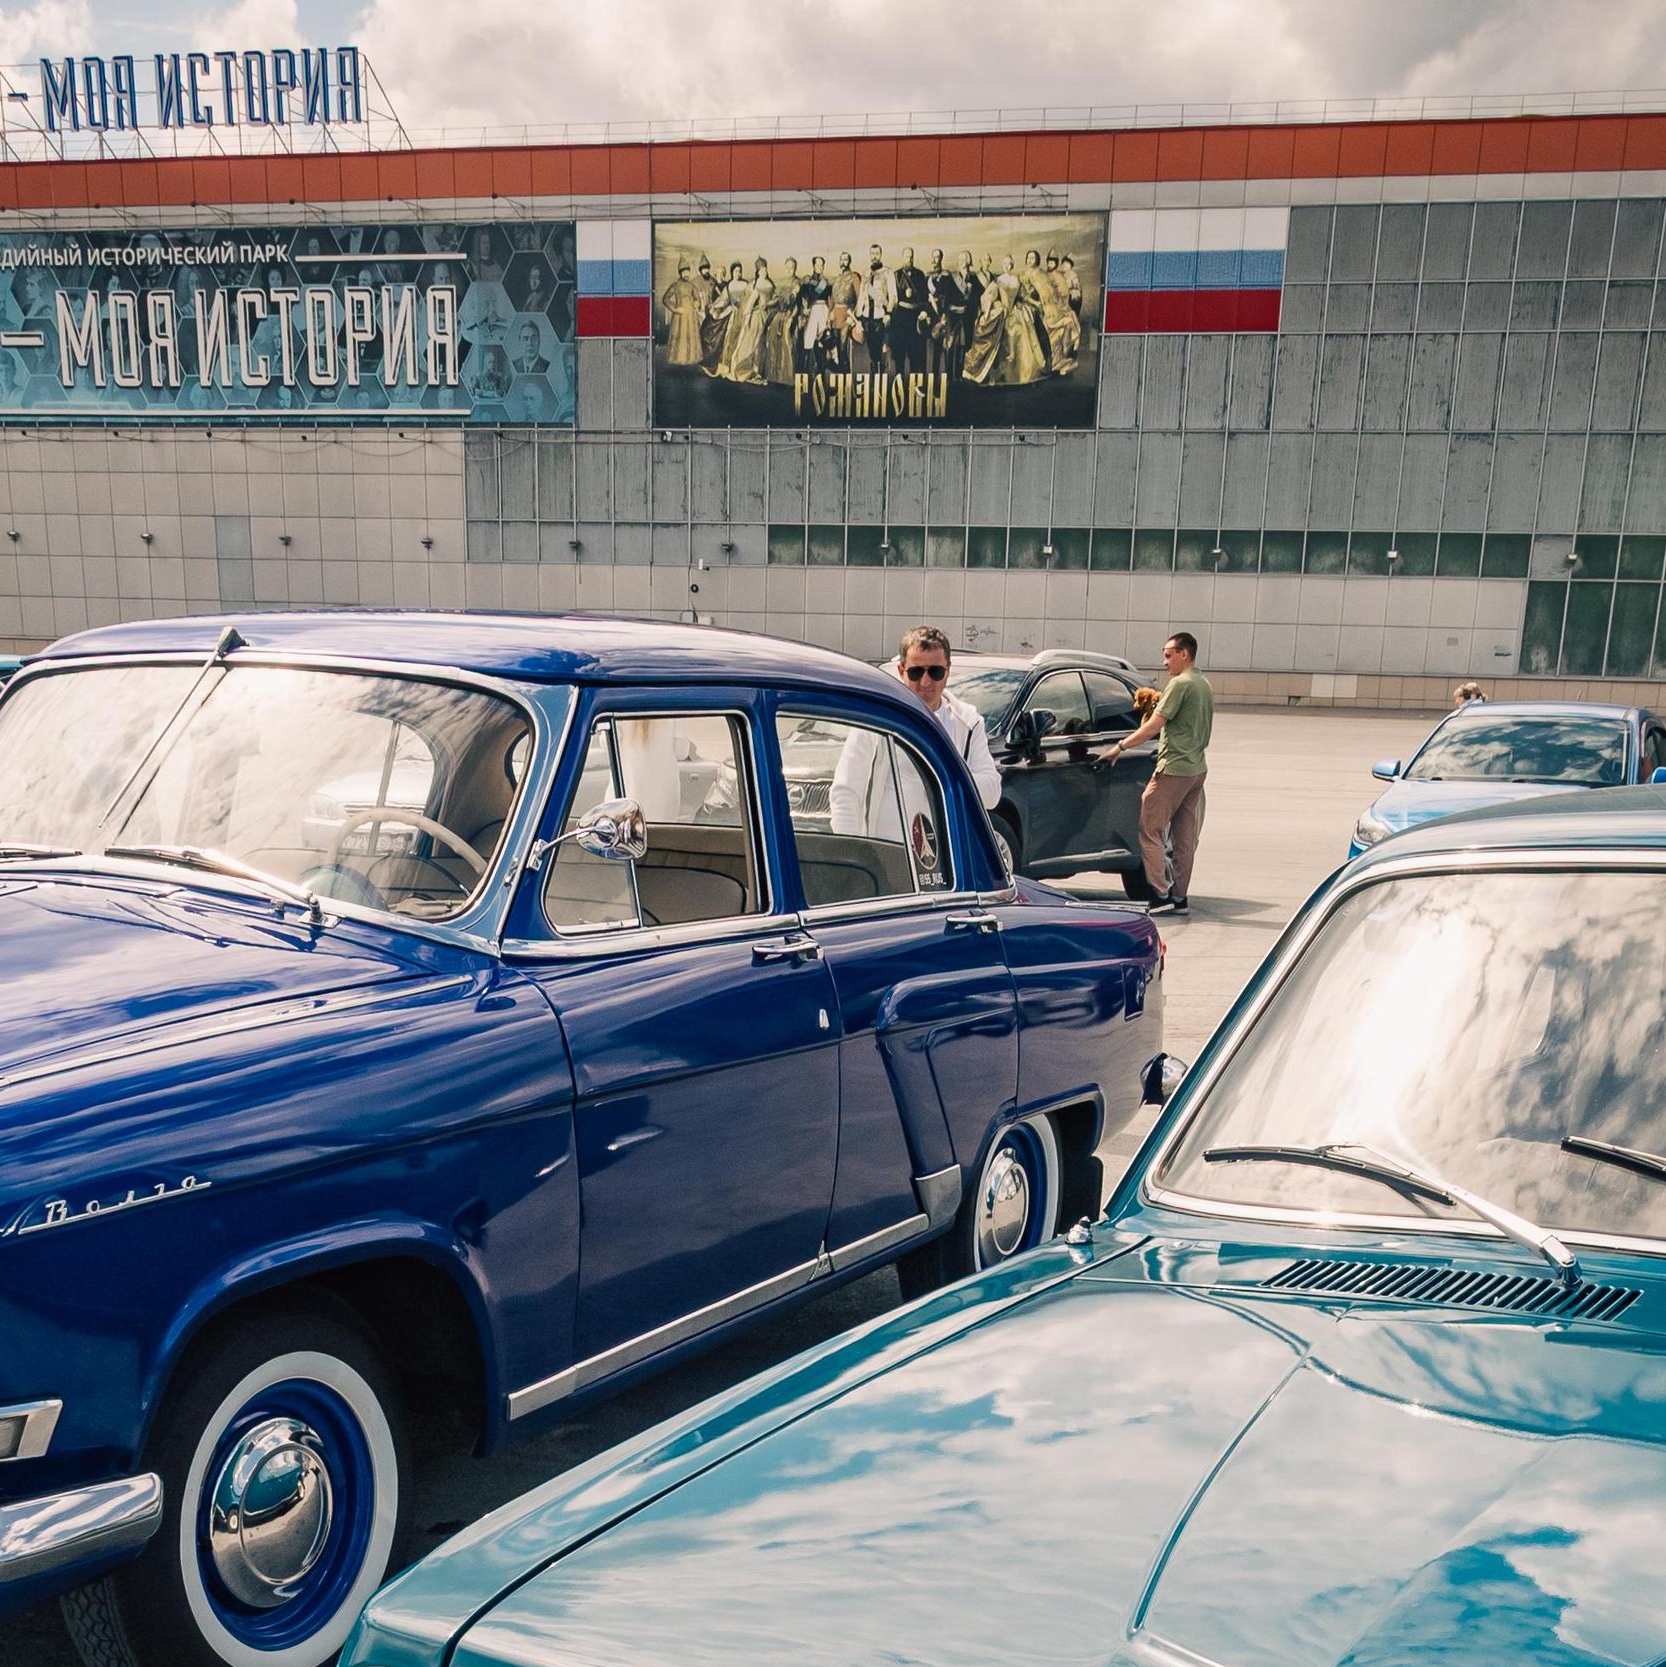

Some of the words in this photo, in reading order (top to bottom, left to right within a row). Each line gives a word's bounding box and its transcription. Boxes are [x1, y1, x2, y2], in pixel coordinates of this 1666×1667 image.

[40, 55, 139, 132] МОЯ
[154, 46, 362, 129] ИСТОРИЯ
[87, 240, 235, 267] ИСТОРИЧЕСКИЙ
[239, 244, 288, 263] ПАРК
[55, 288, 181, 388] МОЯ
[195, 285, 460, 387] ИСТОРИЯ
